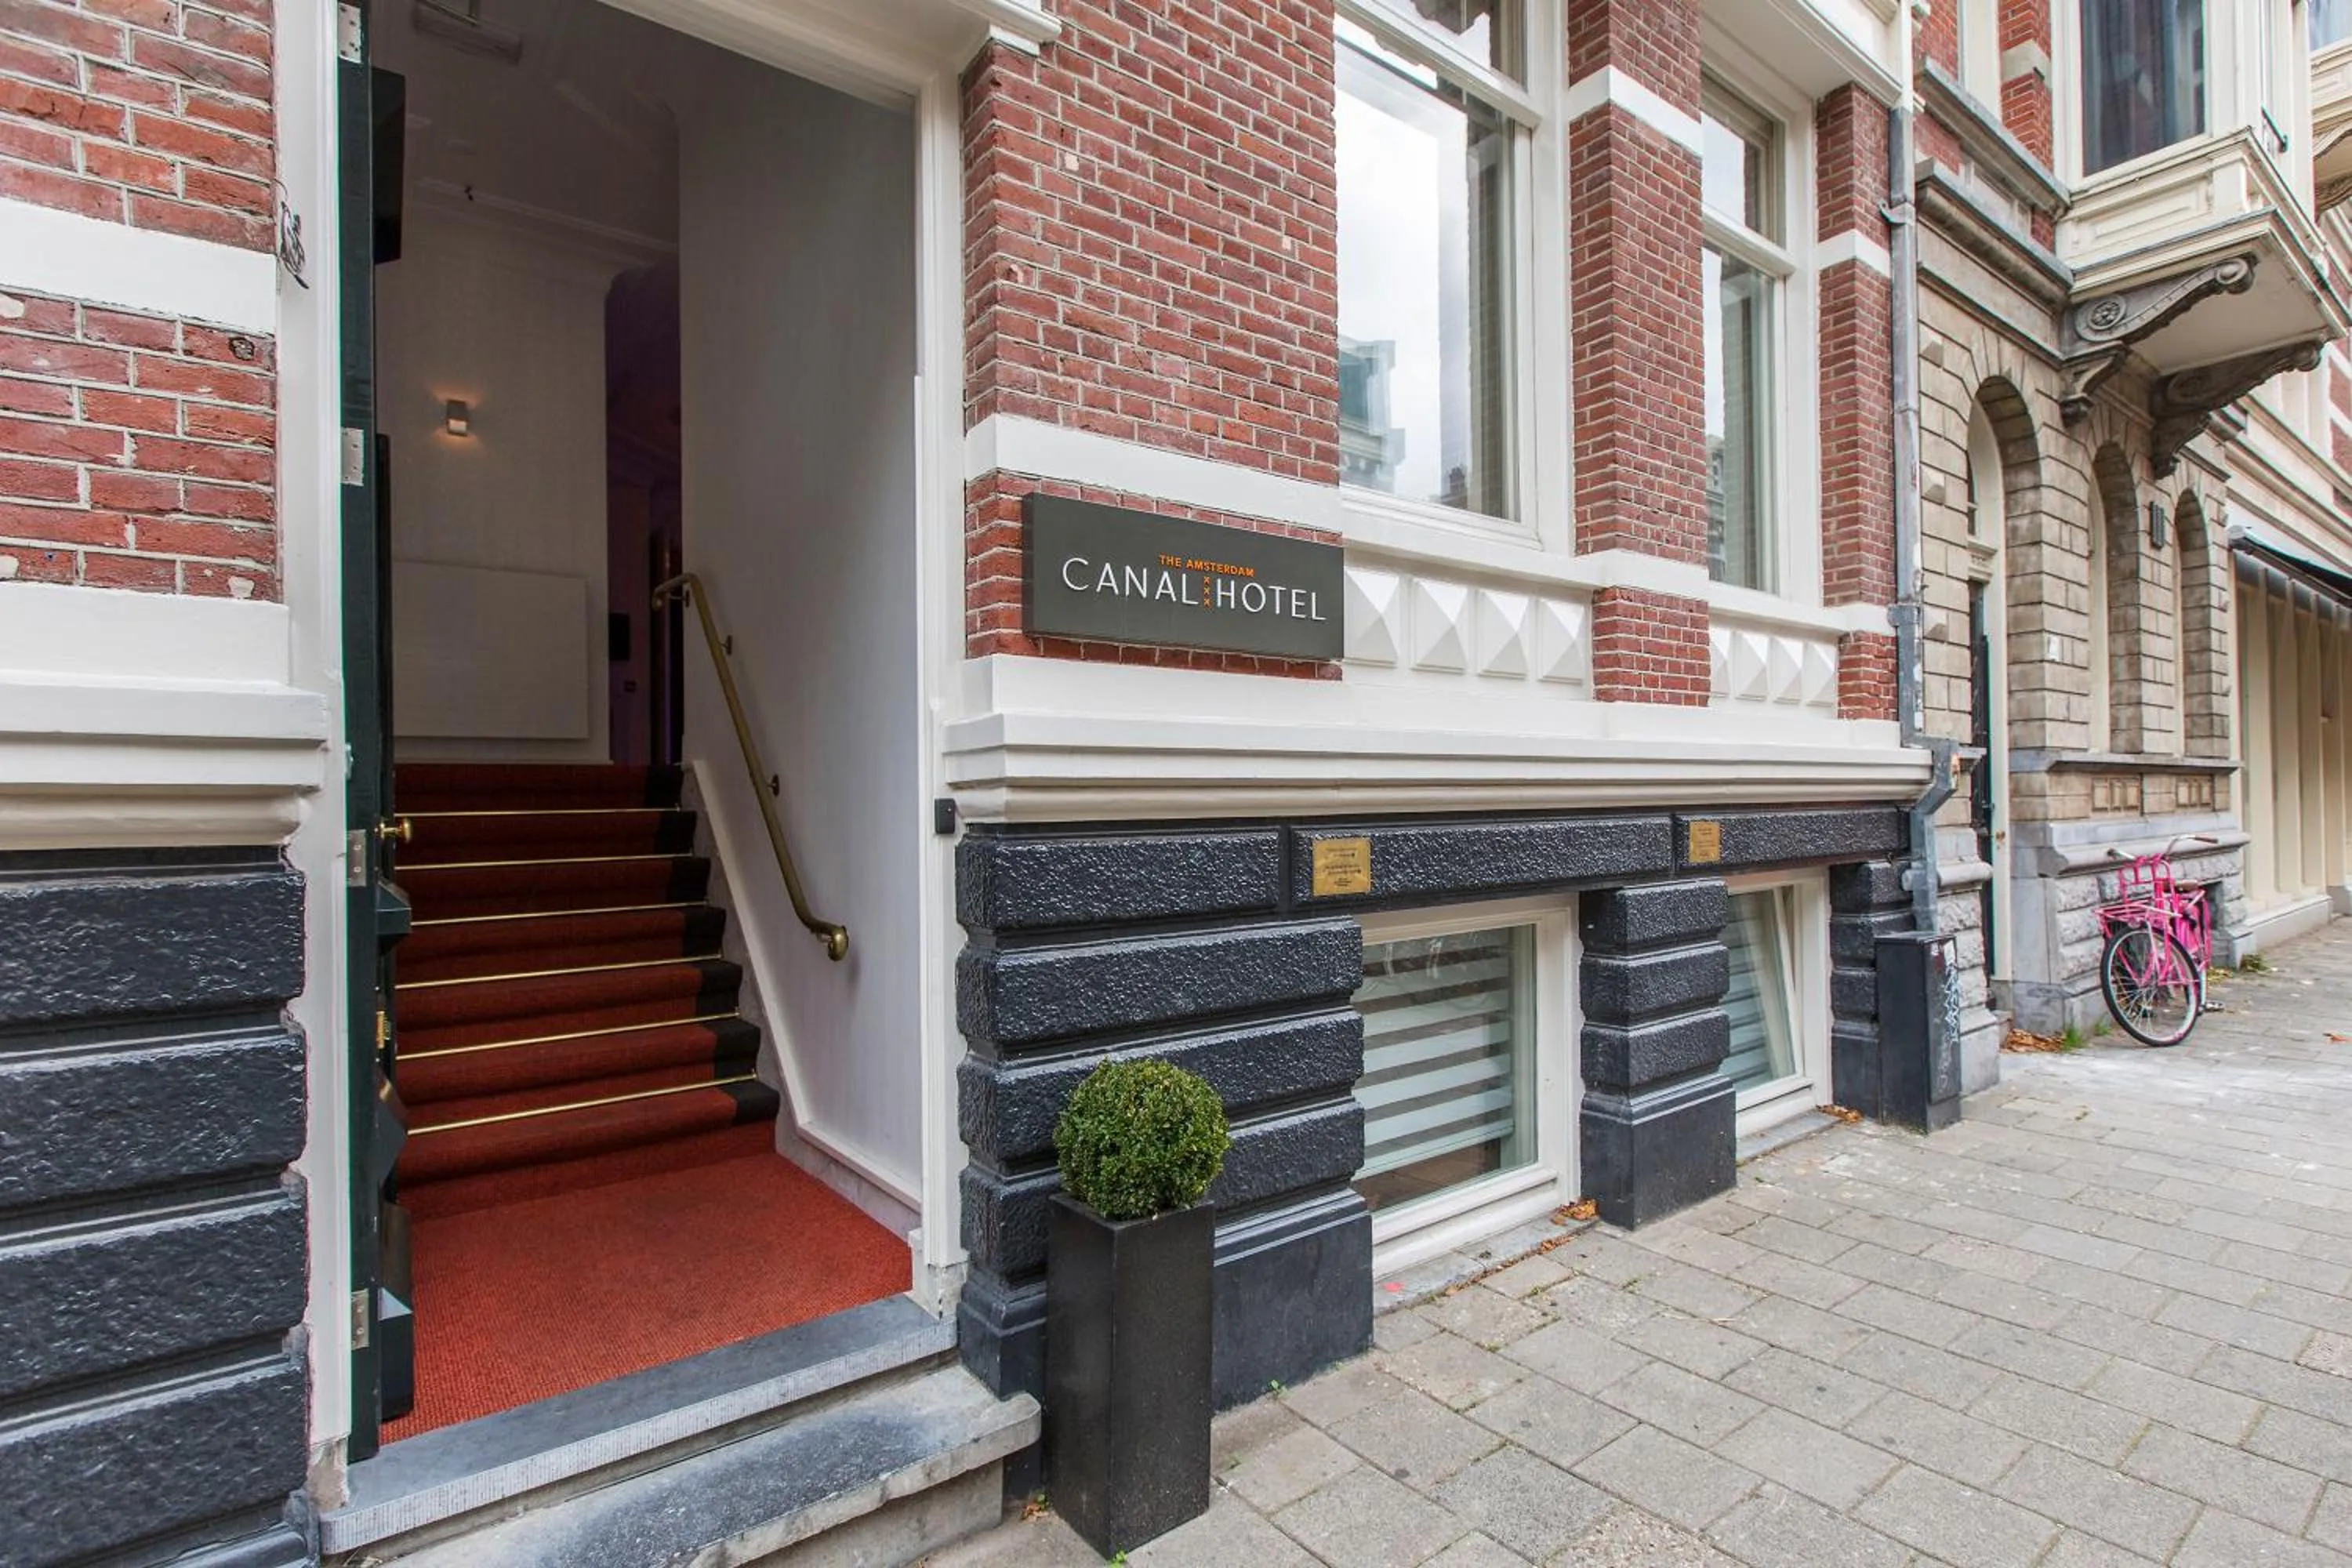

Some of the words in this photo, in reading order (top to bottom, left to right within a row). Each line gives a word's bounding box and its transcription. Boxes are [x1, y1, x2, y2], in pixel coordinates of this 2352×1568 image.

[1160, 554, 1181, 567] THE
[1186, 559, 1255, 577] AMSTERDAM
[1062, 557, 1199, 605] CANAL
[1216, 578, 1327, 621] HOTEL
